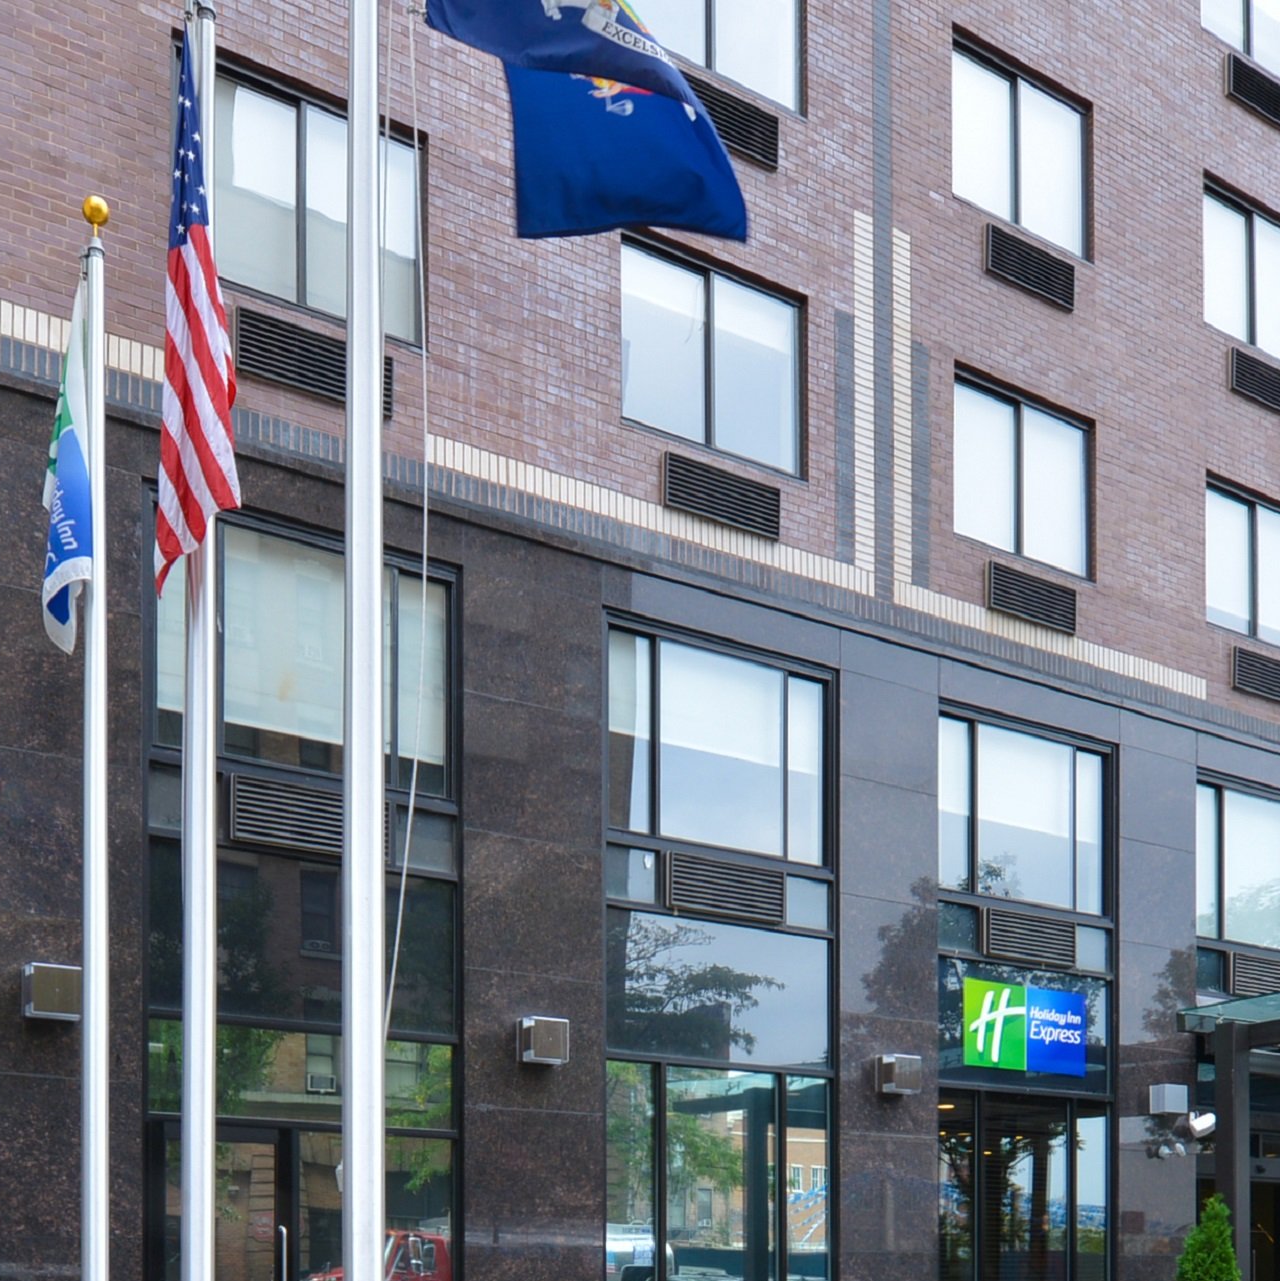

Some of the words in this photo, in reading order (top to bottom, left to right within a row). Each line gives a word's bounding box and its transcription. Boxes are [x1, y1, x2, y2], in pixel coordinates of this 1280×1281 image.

[57, 519, 78, 551] Inn
[1029, 1006, 1066, 1026] Holiday
[1066, 1010, 1082, 1025] Inn
[1029, 1021, 1082, 1045] Express
